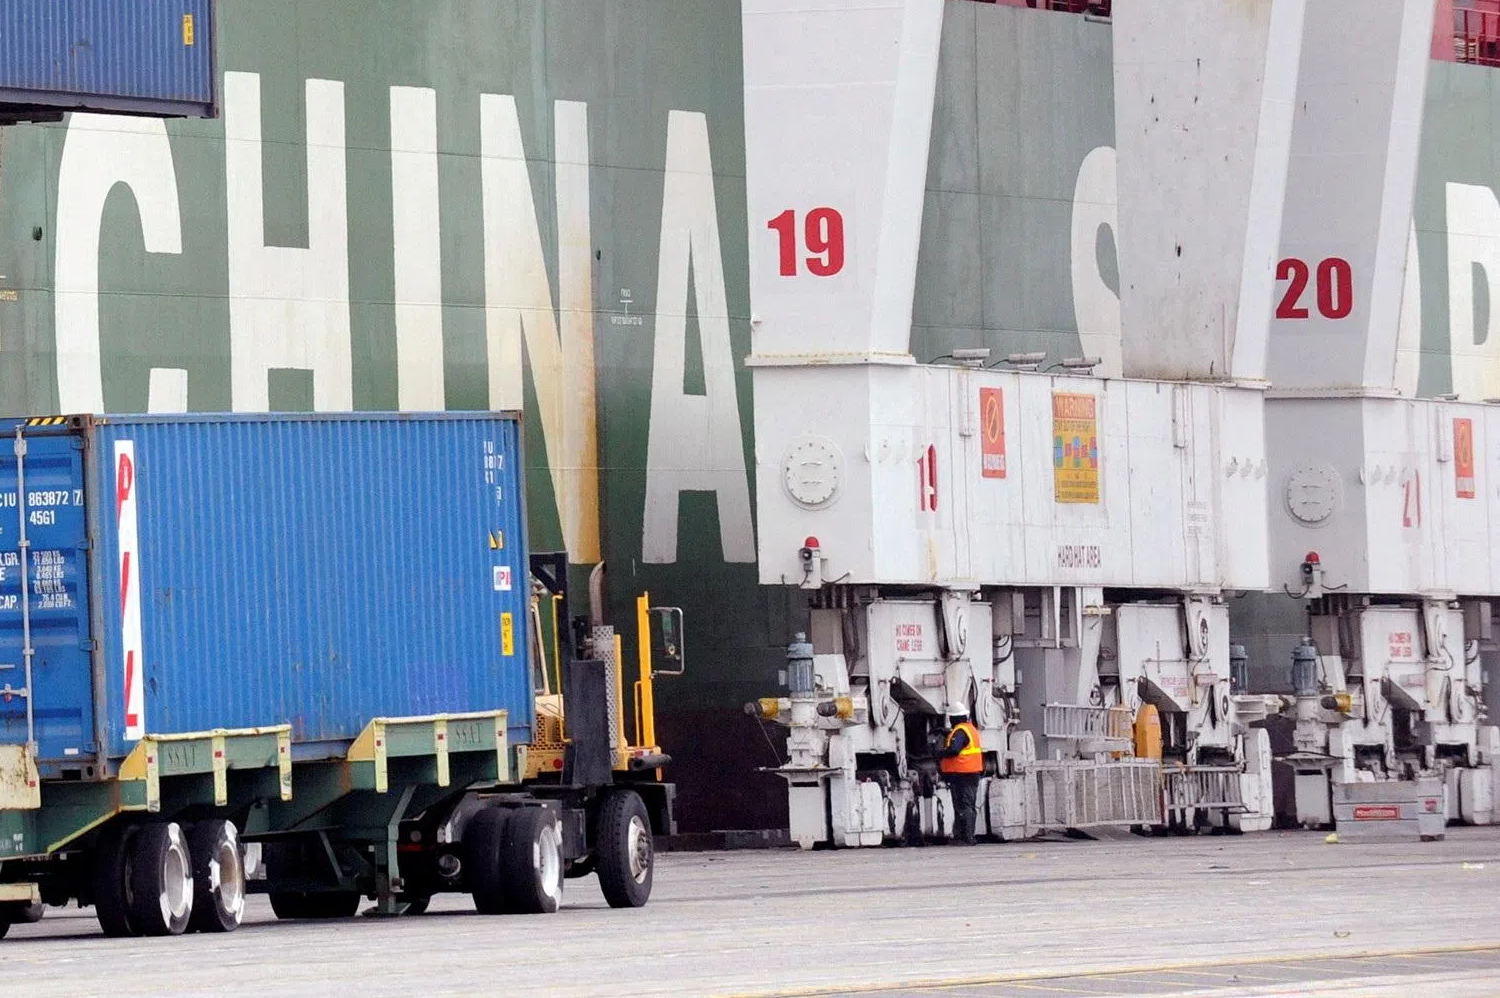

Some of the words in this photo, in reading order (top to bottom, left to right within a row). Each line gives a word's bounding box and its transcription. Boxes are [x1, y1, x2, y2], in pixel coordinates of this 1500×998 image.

[767, 207, 845, 277] 19
[1275, 257, 1353, 320] 20
[55, 71, 757, 564] CHINA
[1056, 396, 1094, 418] WARNING
[28, 491, 69, 506] 863872
[75, 490, 82, 505] 7
[29, 510, 55, 525] 45G1
